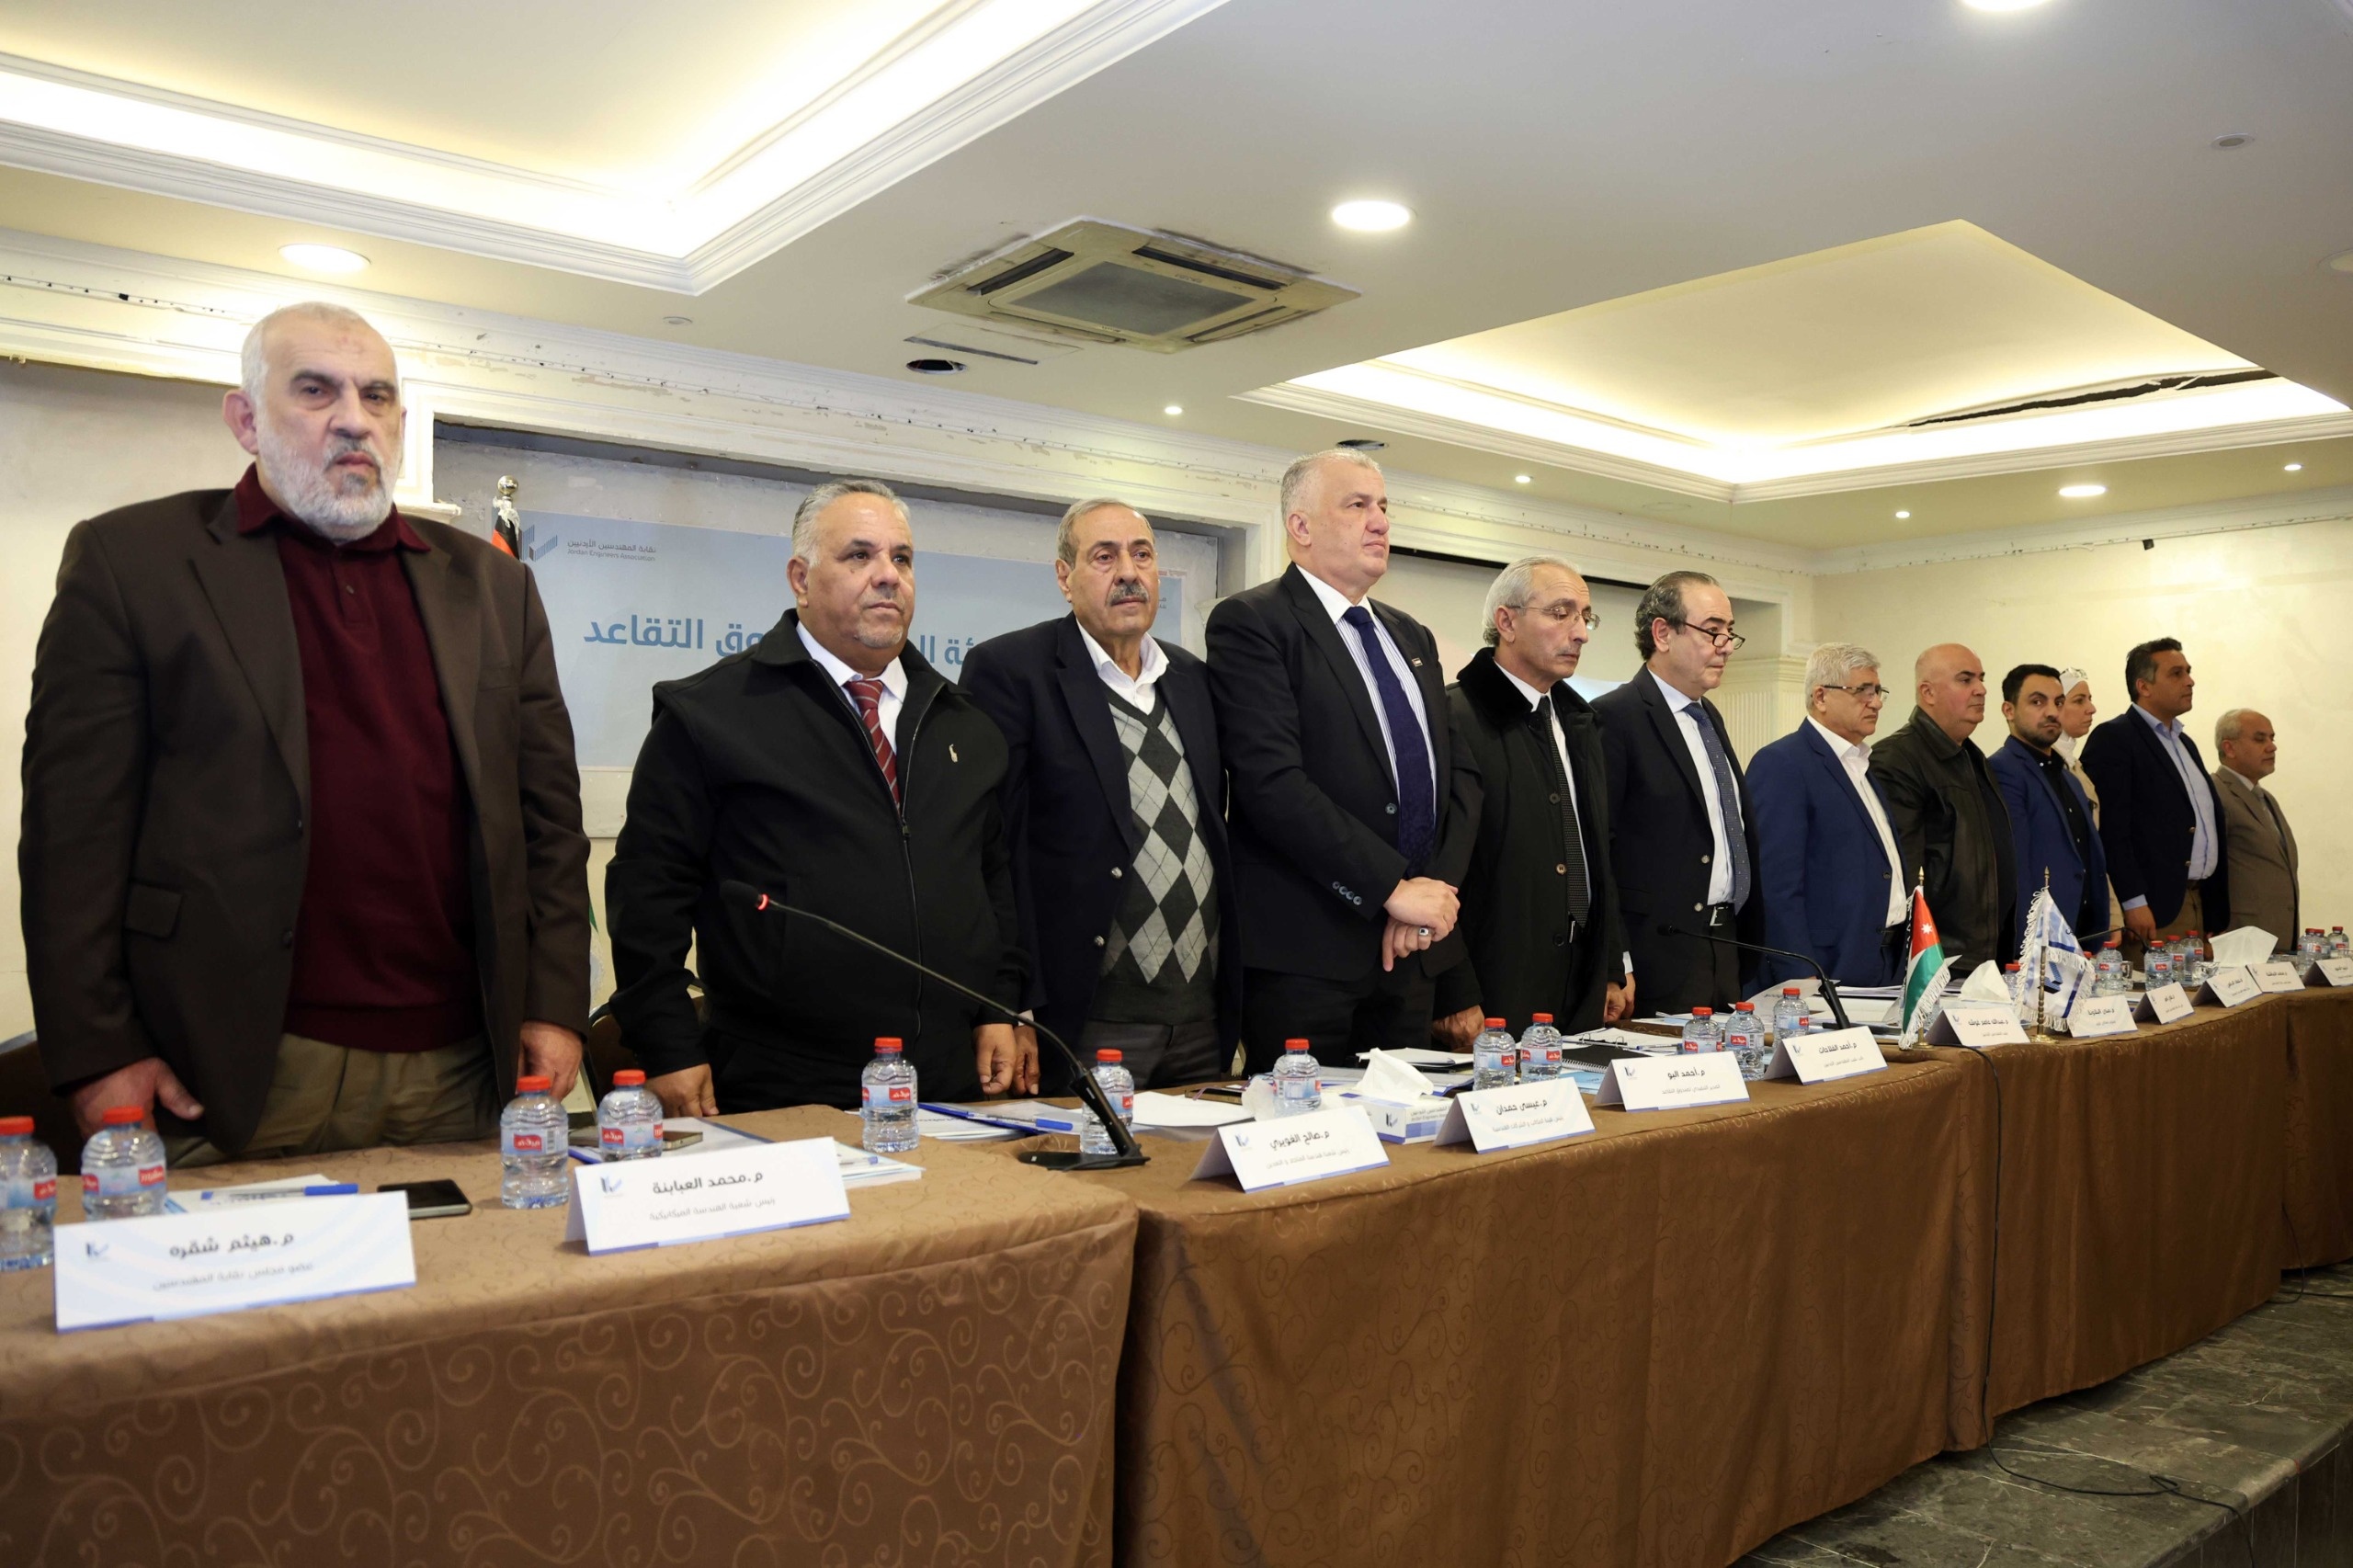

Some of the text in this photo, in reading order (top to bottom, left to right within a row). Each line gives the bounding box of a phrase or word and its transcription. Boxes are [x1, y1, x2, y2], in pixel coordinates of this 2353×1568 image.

[597, 542, 636, 551] المهندسين
[638, 545, 656, 553] نقابة
[589, 550, 620, 559] Engineers
[620, 552, 655, 562] Association
[584, 614, 703, 649] التقاعد
[1495, 1103, 1518, 1116] حمدان
[653, 1170, 764, 1196] م.محمد العبابنة
[169, 1233, 295, 1260] م.هيثم شقره
